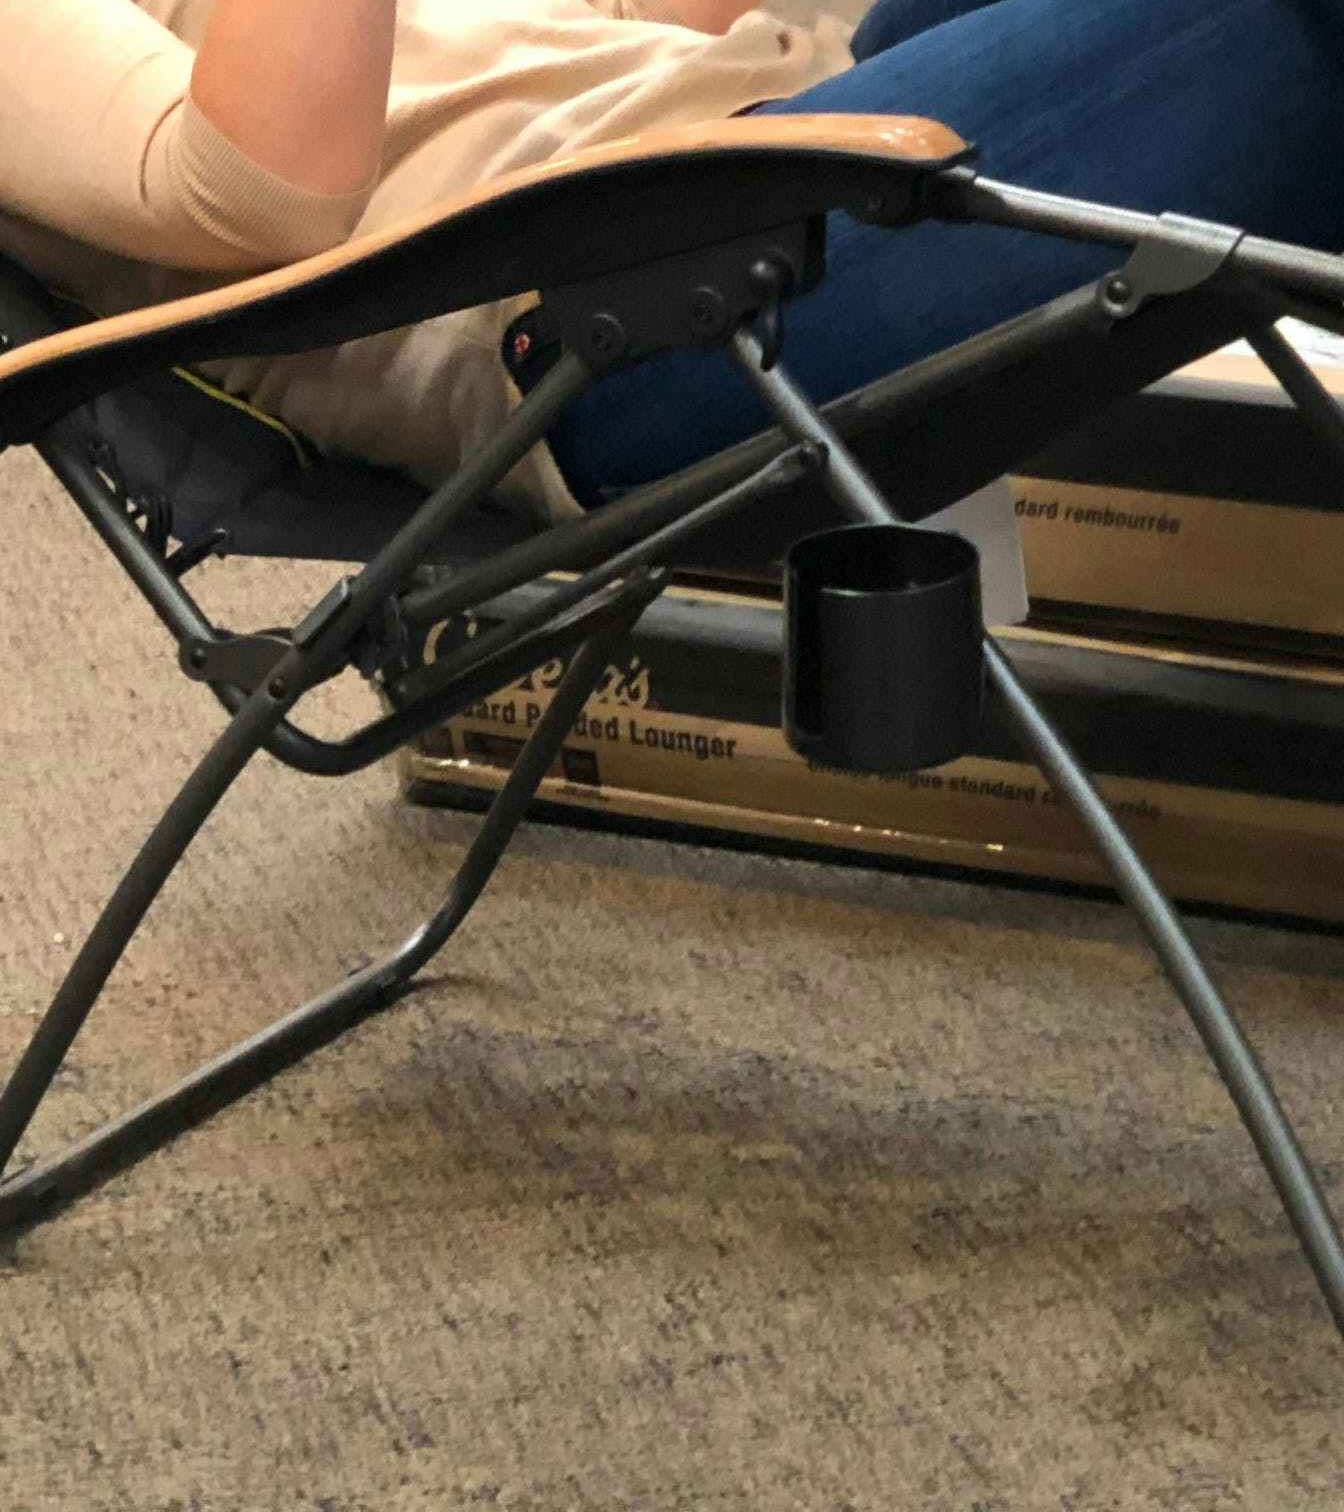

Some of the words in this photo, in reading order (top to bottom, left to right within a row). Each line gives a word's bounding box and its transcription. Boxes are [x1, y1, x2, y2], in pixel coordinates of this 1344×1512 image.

[1014, 498, 1058, 519] dard
[1063, 505, 1182, 535] rembourrée
[629, 718, 738, 760] Lounger
[950, 774, 1035, 806] standard
